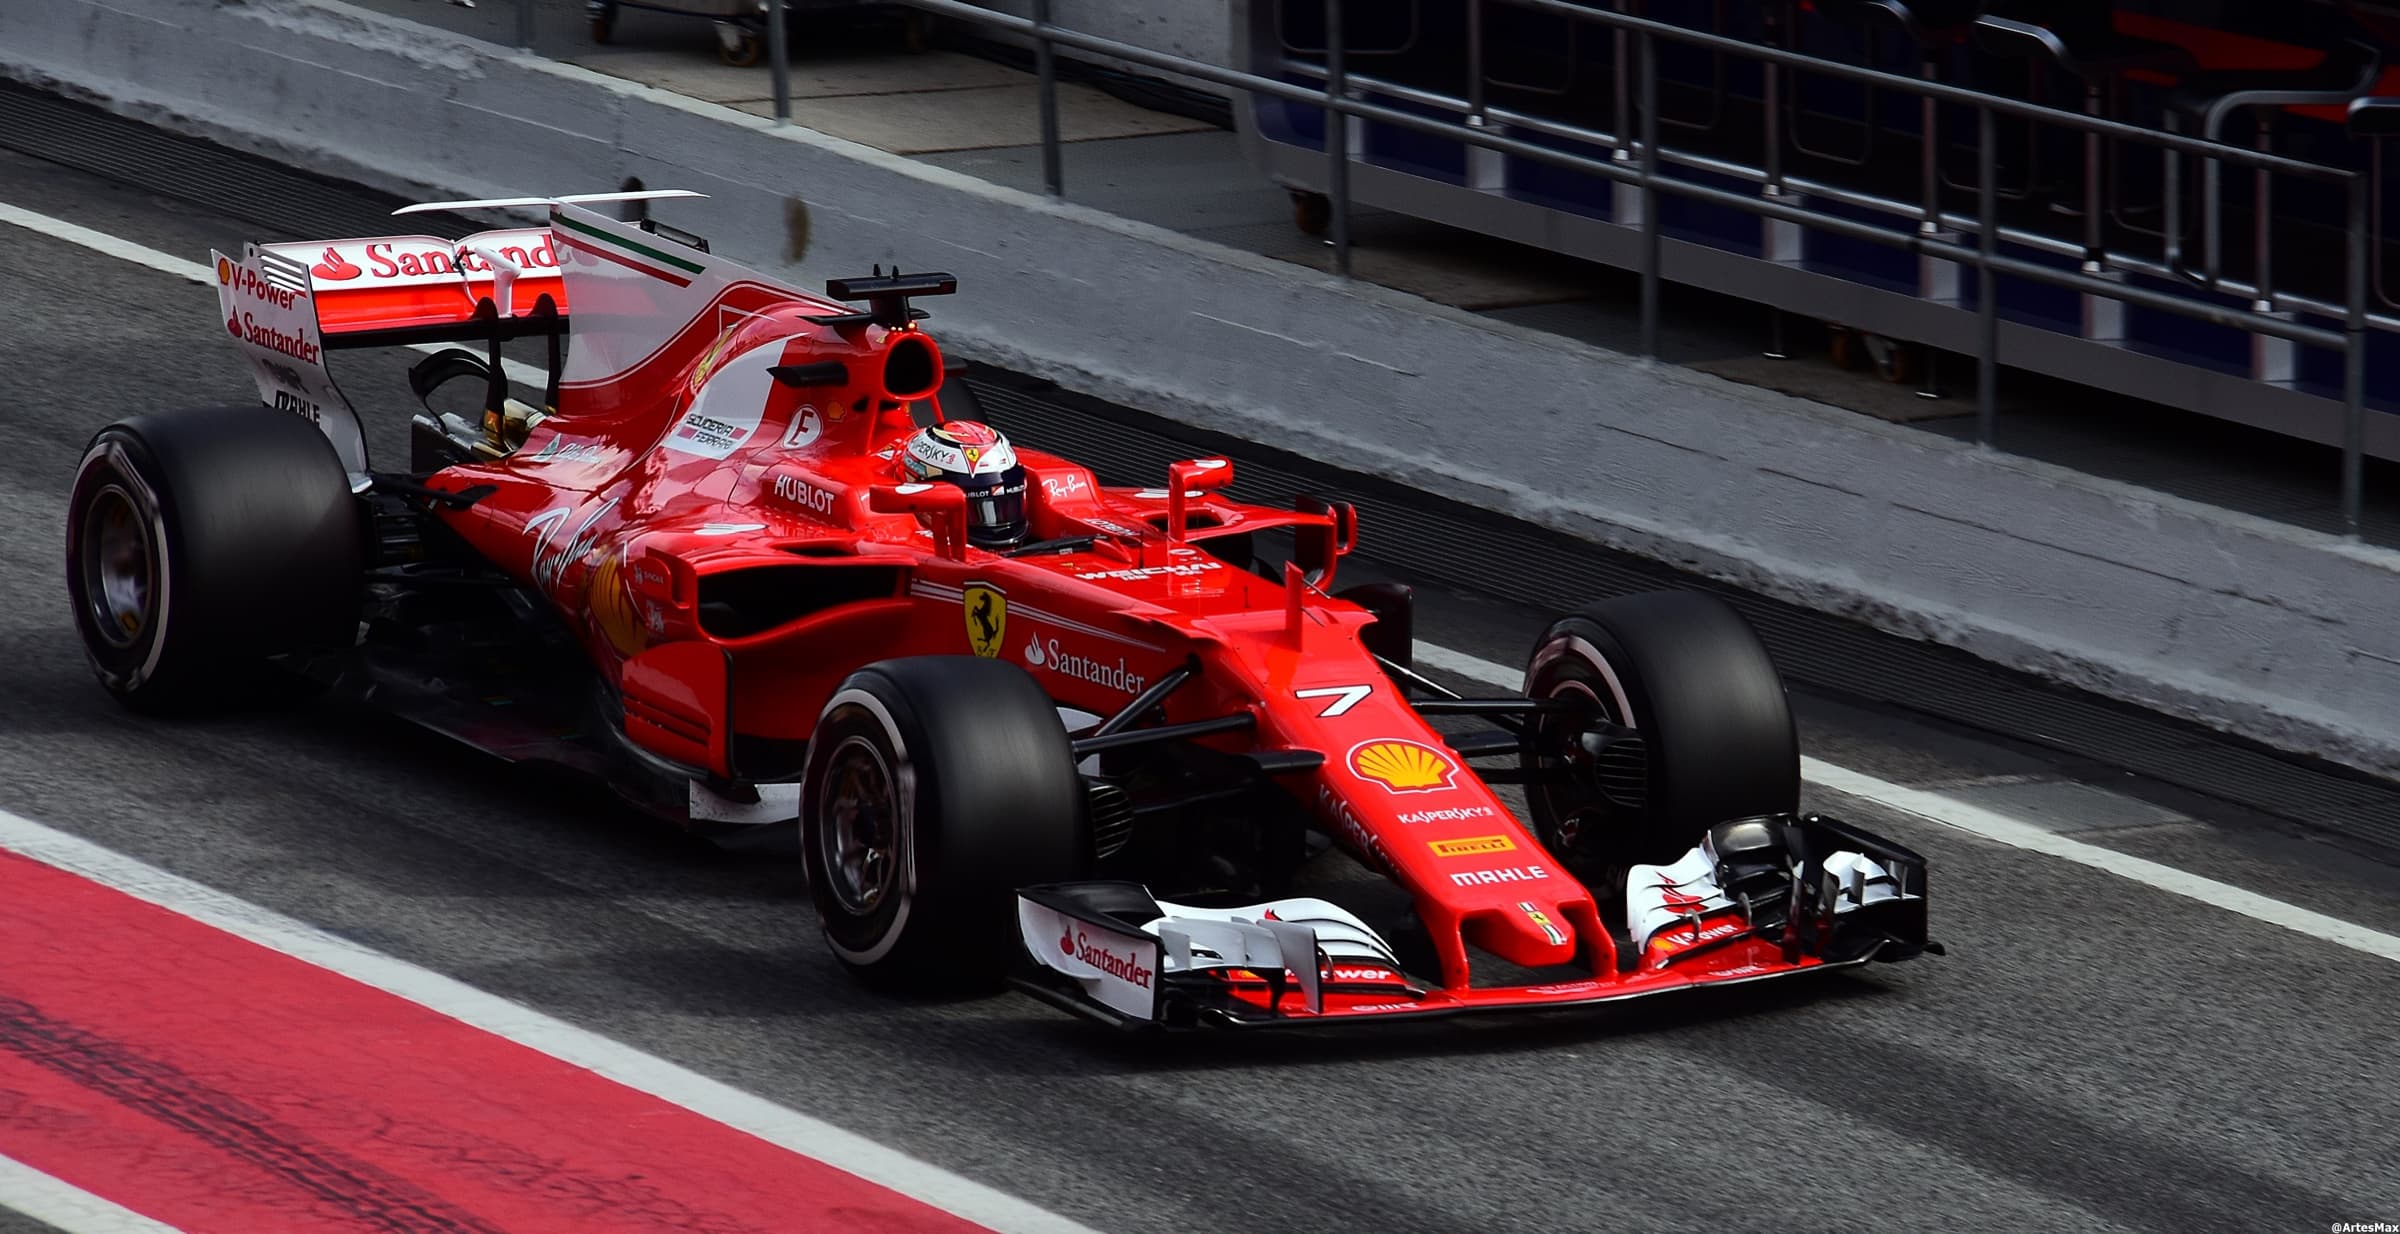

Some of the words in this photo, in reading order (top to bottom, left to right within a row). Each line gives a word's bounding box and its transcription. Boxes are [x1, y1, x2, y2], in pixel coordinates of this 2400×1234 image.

[231, 266, 295, 311] V-Power
[243, 311, 319, 366] Santander
[917, 441, 950, 461] PERSKY
[774, 474, 834, 515] HUBLOT
[964, 490, 989, 498] UBLOT
[1041, 474, 1087, 497] Ray-Ban
[1048, 639, 1144, 695] Santander
[1295, 685, 1373, 717] 7
[1397, 806, 1484, 824] KASPERSKY
[1450, 866, 1549, 887] MAHLE
[1075, 932, 1152, 989] Santander
